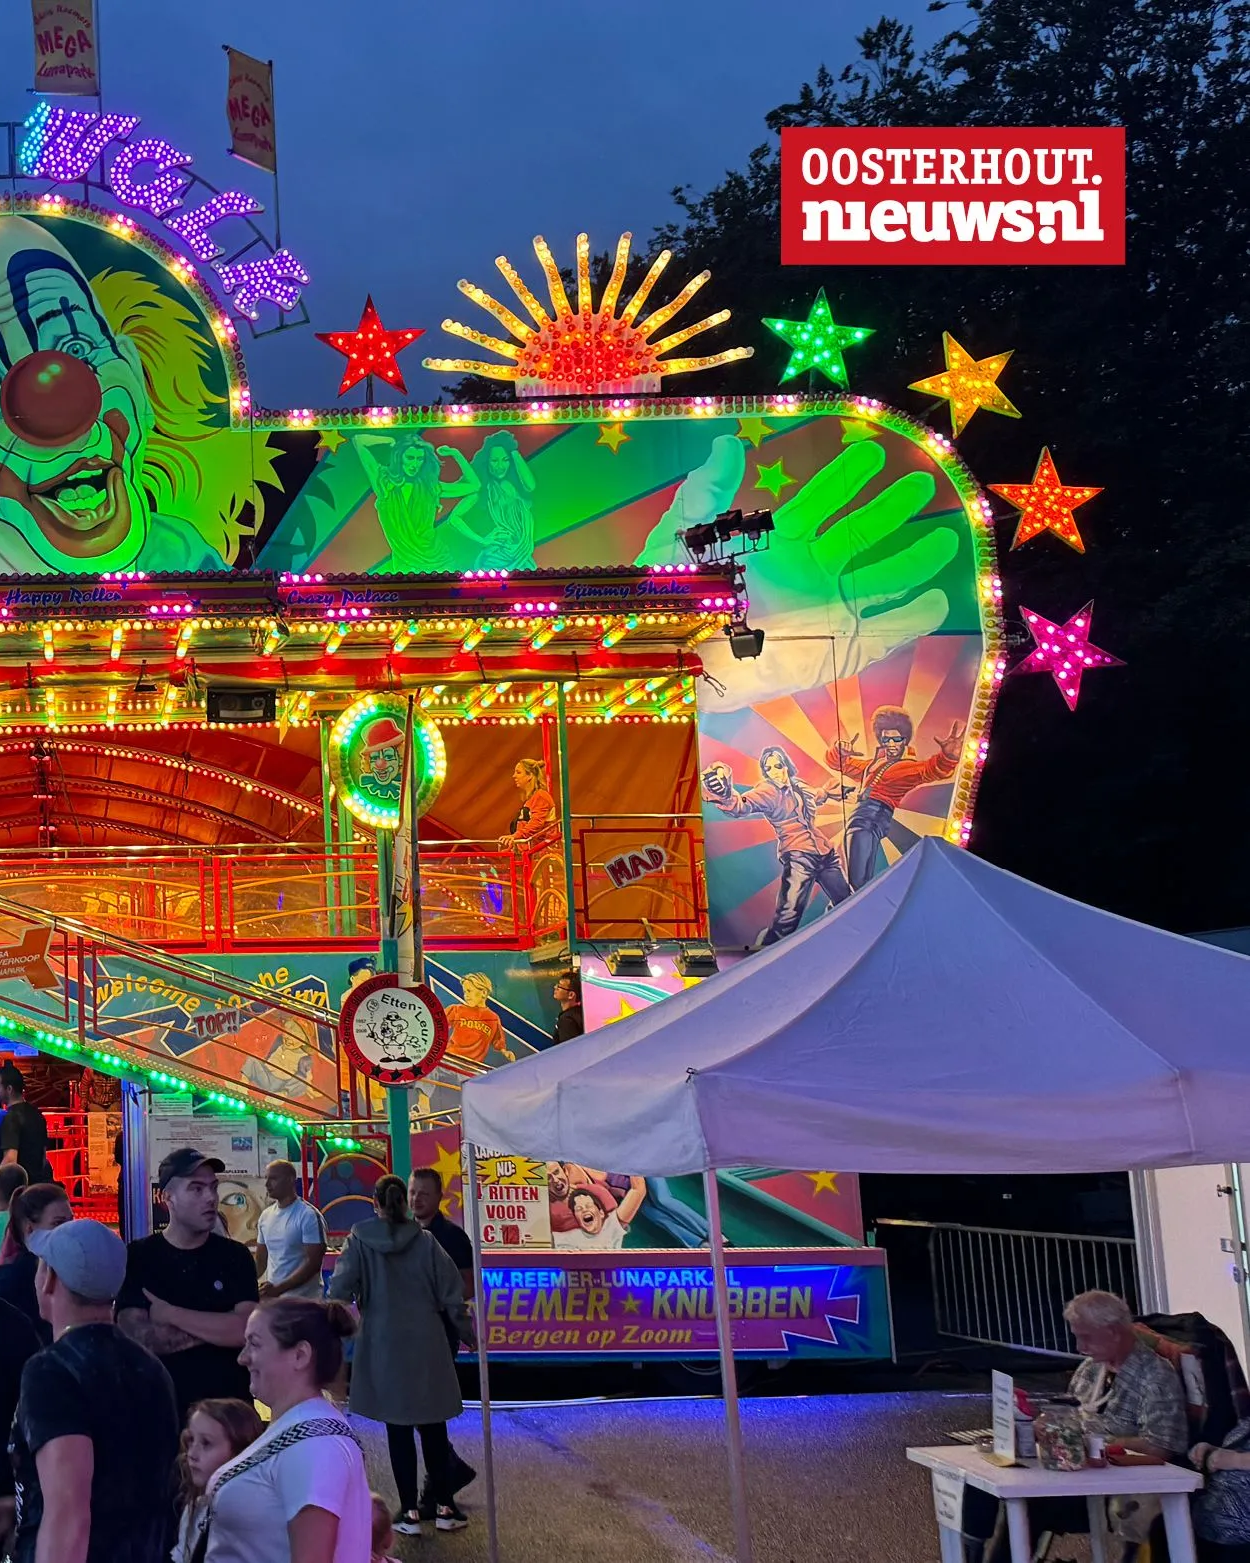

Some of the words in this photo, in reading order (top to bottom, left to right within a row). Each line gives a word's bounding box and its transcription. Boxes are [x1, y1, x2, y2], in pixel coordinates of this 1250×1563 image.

[37, 26, 92, 58] MEGA
[36, 61, 95, 79] Lunapark
[229, 95, 271, 127] MEGA
[3, 588, 62, 606] Happy
[67, 588, 123, 602] Roller
[286, 589, 335, 608] Crazy
[340, 587, 399, 607] Palace
[564, 582, 631, 600] Sjimmy
[635, 579, 691, 597] Shake
[607, 847, 665, 887] MAD
[91, 973, 201, 1012] welcome
[193, 1010, 239, 1035] TOP!!
[495, 1160, 517, 1177] NU:
[489, 1185, 539, 1201] RITTEN
[485, 1204, 527, 1220] VOOR
[652, 1286, 812, 1320] KNUBBEN
[488, 1325, 581, 1348] Bergen
[586, 1330, 617, 1348] op
[622, 1324, 693, 1345] Zoom
